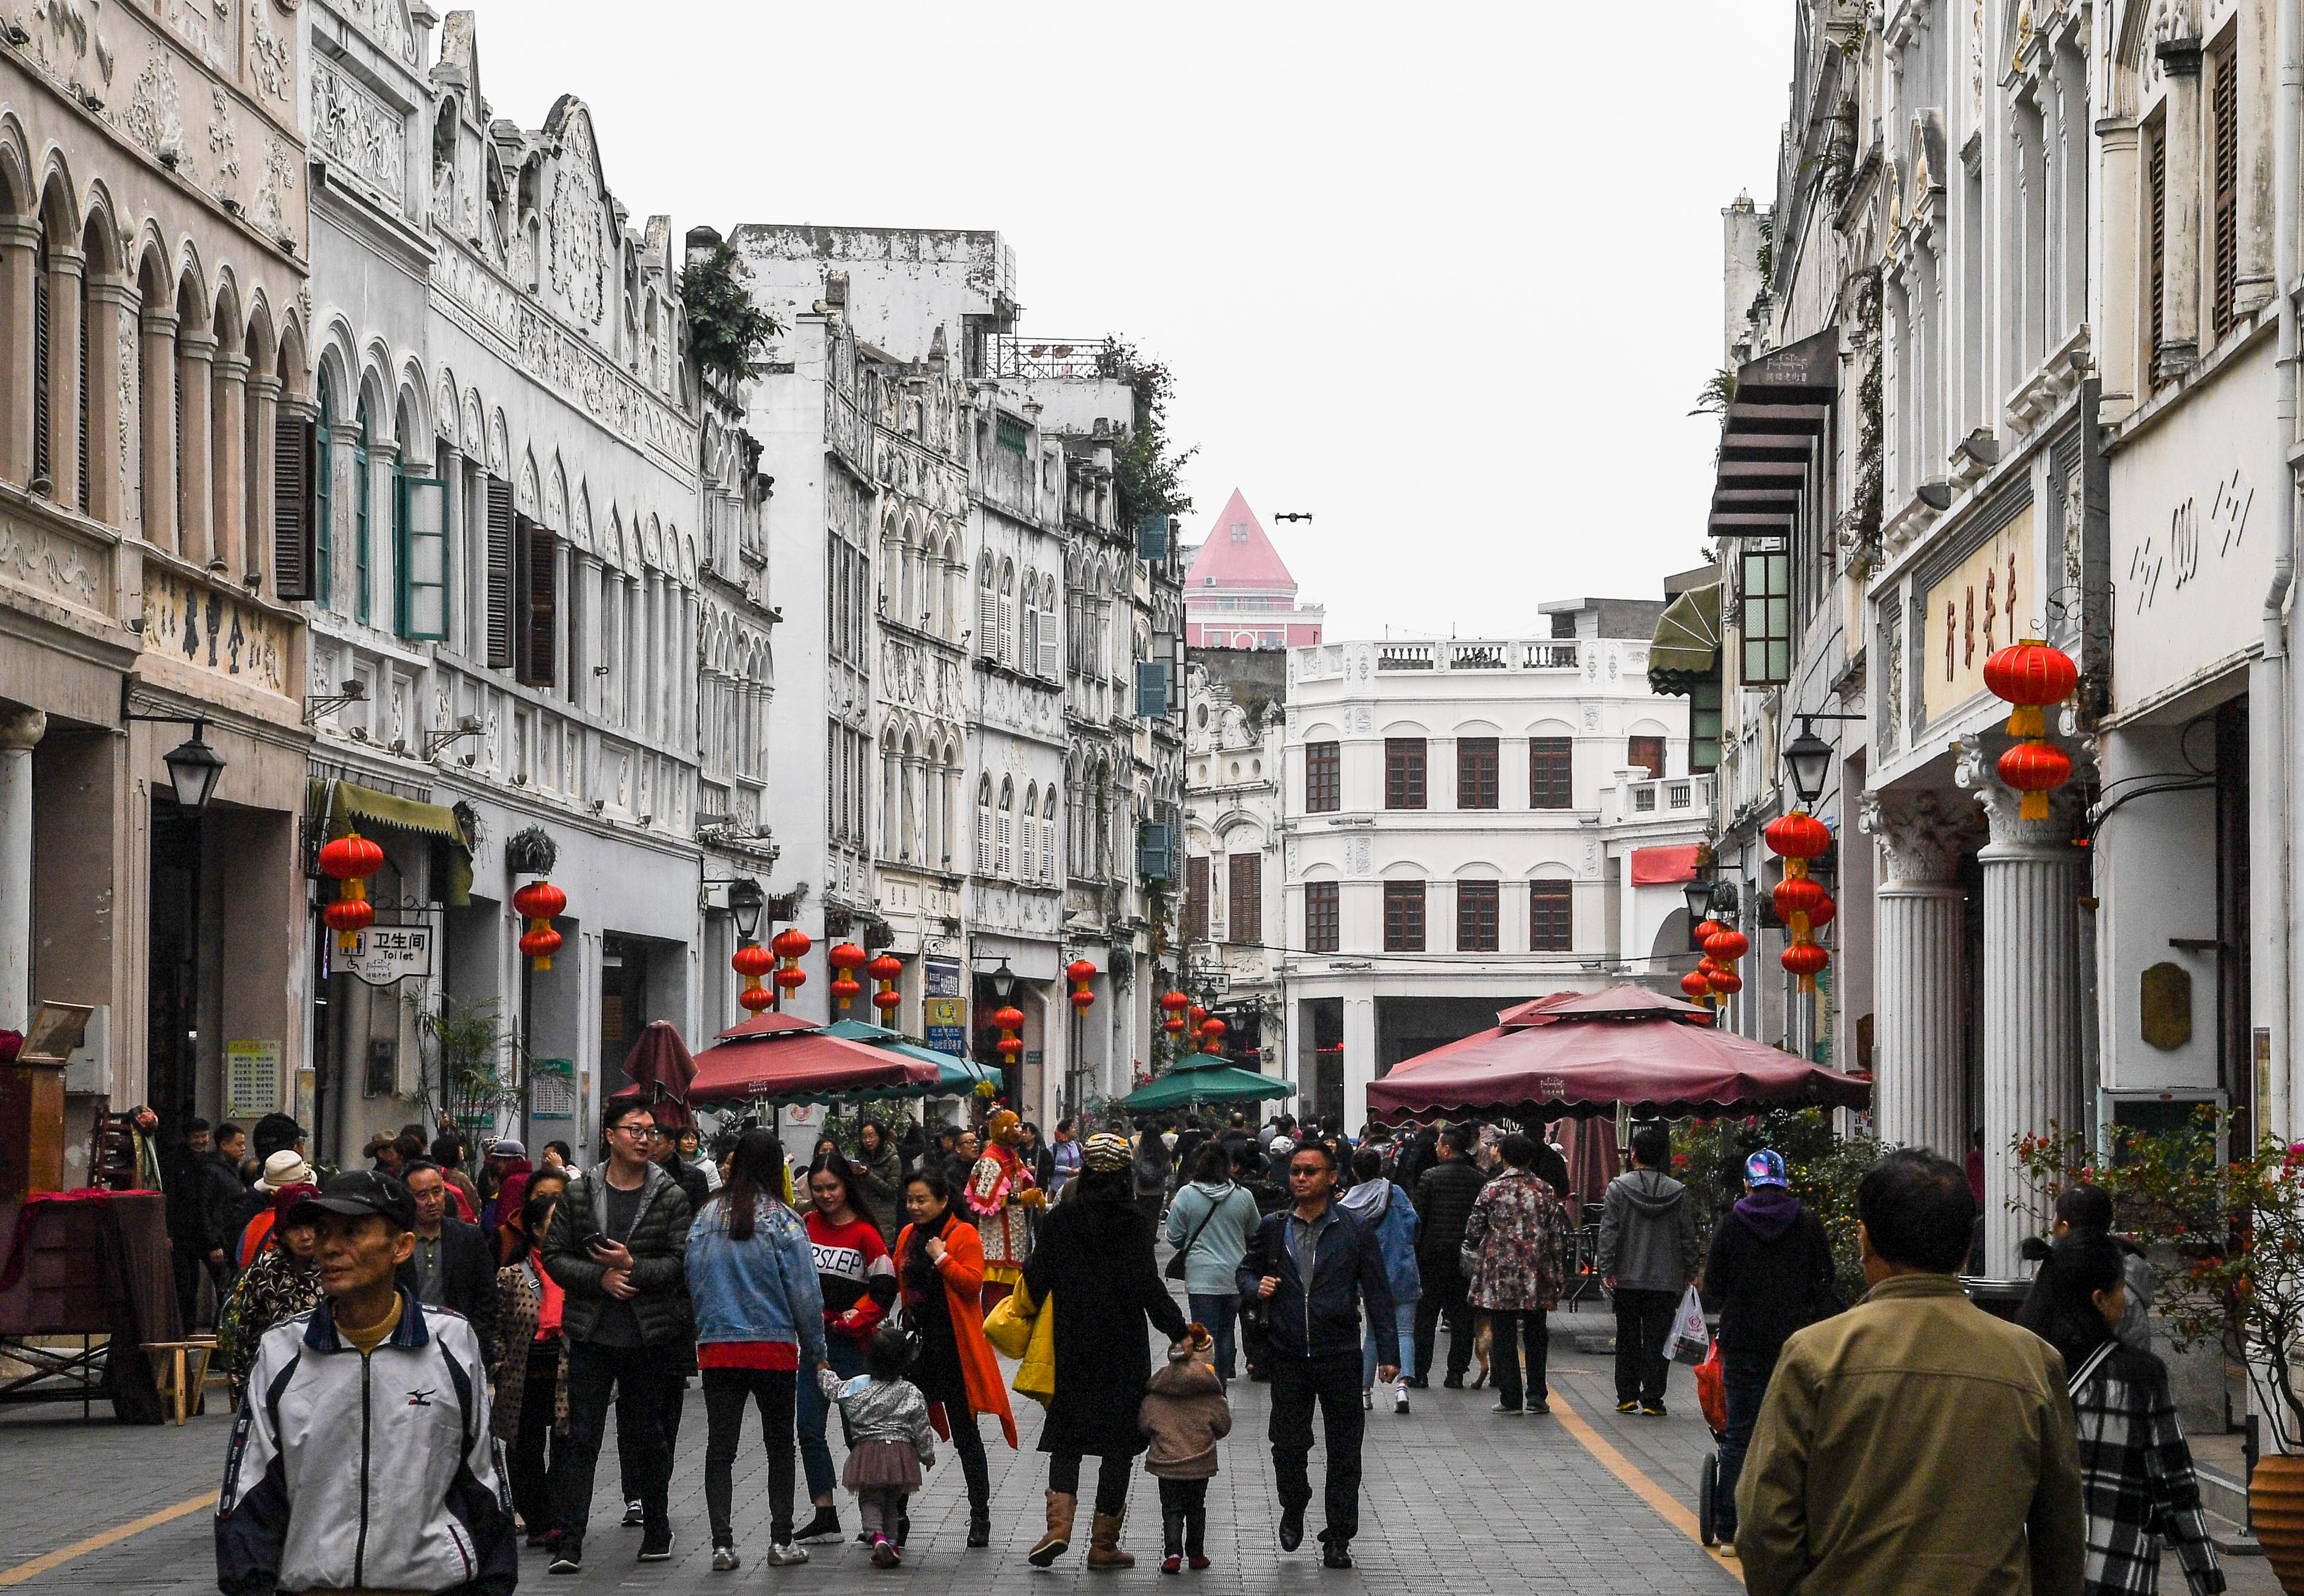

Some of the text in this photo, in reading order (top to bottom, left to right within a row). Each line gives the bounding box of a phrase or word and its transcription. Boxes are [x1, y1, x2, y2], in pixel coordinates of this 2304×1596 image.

[373, 933, 425, 950] 卫生间
[383, 950, 413, 960] Toilet
